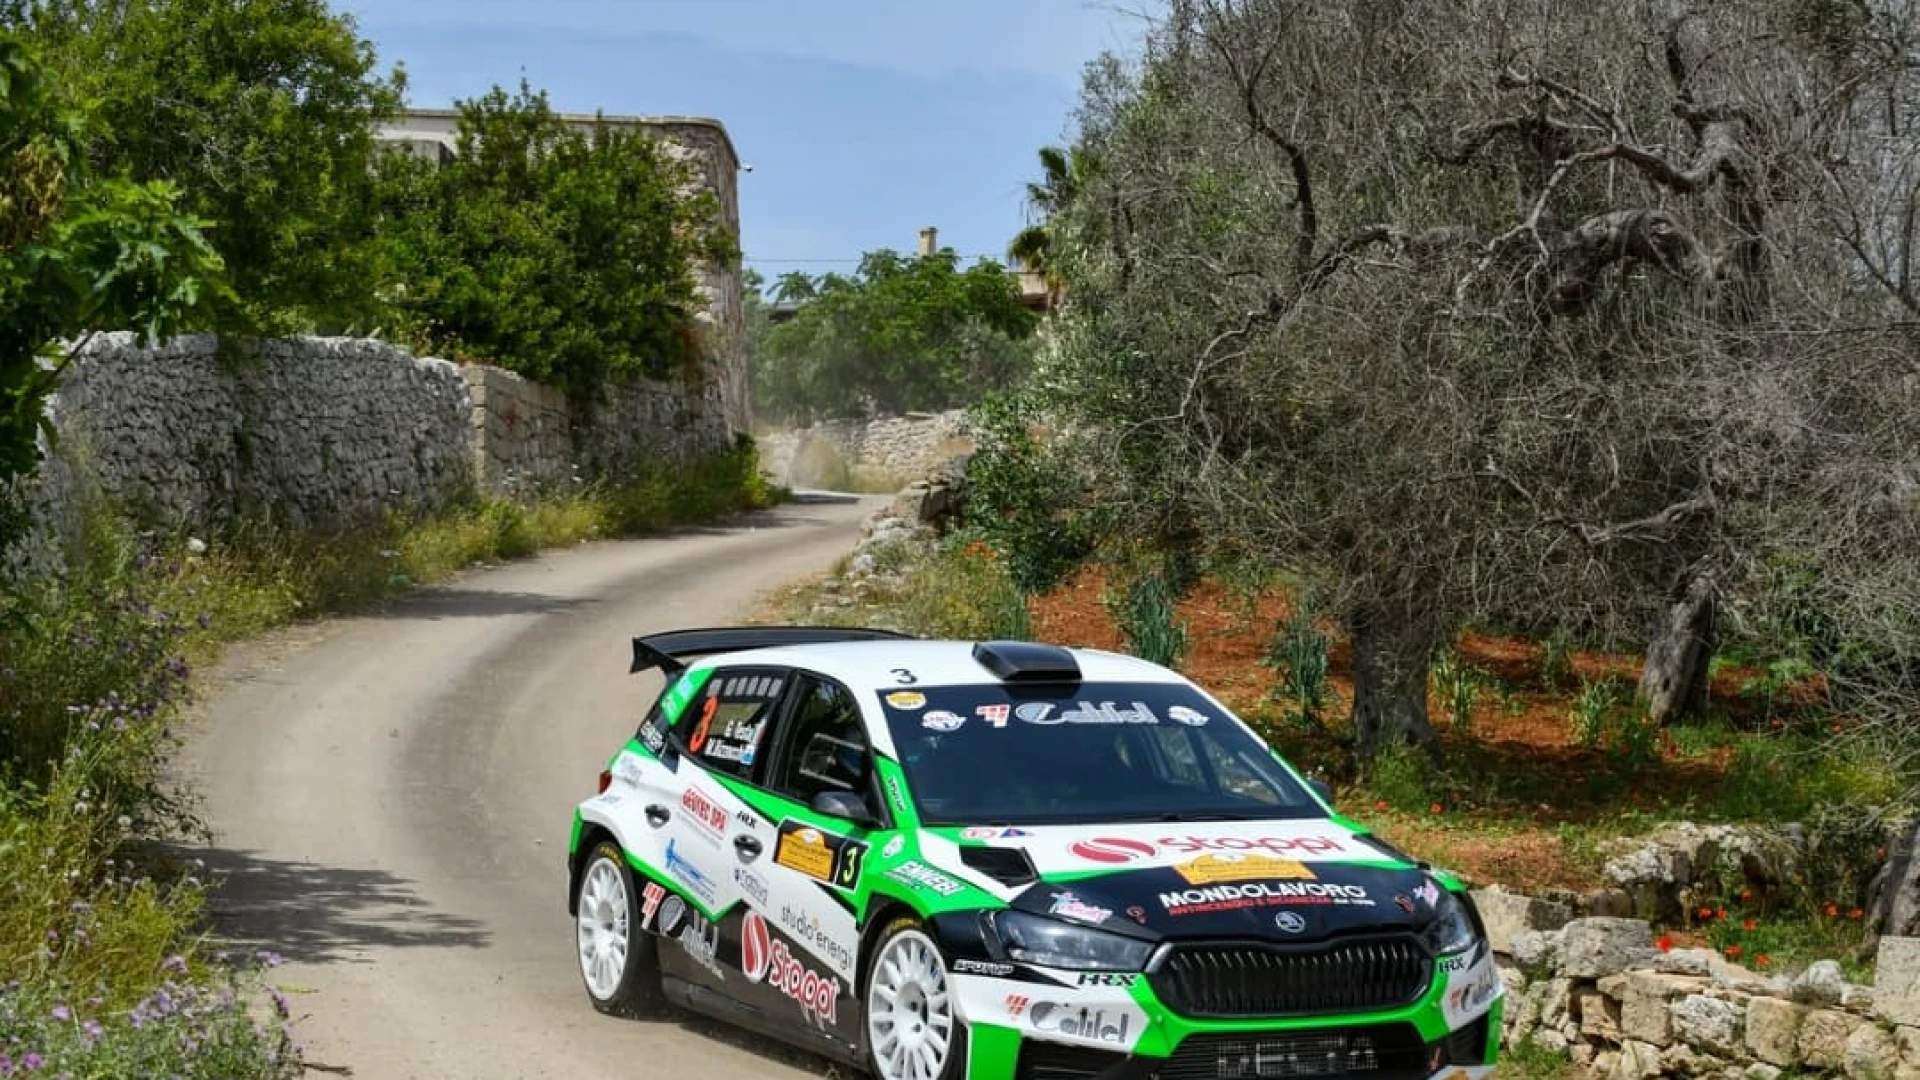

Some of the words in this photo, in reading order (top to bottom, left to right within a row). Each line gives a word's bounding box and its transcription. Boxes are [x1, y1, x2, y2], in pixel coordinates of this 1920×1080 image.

[889, 668, 918, 684] 3
[690, 696, 718, 753] 3
[842, 846, 859, 883] 3
[1159, 883, 1368, 908] MONDOLAVORO
[1076, 971, 1138, 987] HRX
